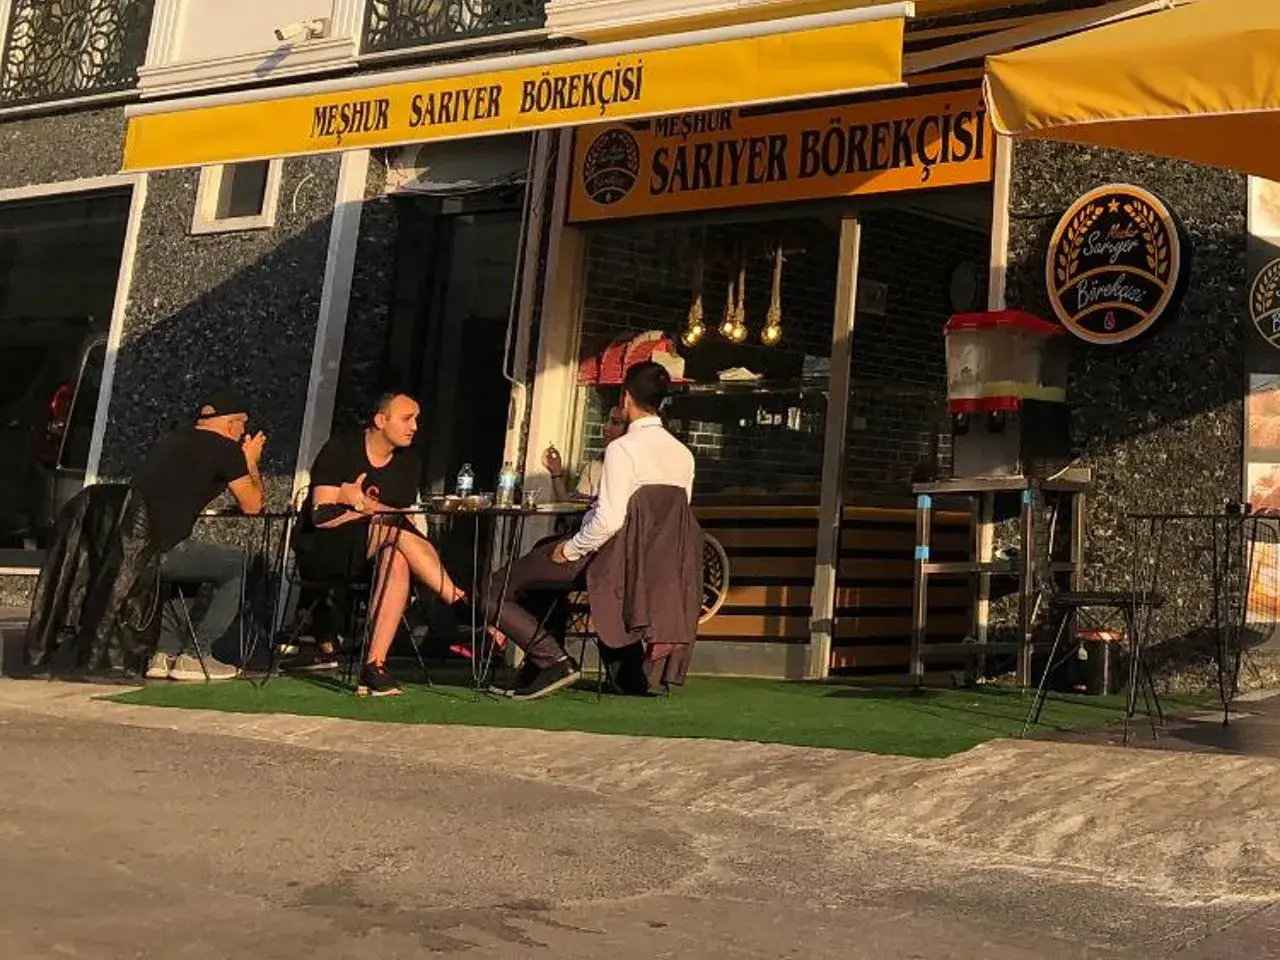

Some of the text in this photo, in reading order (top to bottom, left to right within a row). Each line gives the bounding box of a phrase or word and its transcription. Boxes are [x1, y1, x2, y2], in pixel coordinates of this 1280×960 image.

[310, 59, 644, 145] MEŞHUR SARIYER BÖREKÇİSİ
[653, 108, 733, 138] MEŞHUR
[649, 100, 986, 196] SARIYER BÖREKÇİSİ
